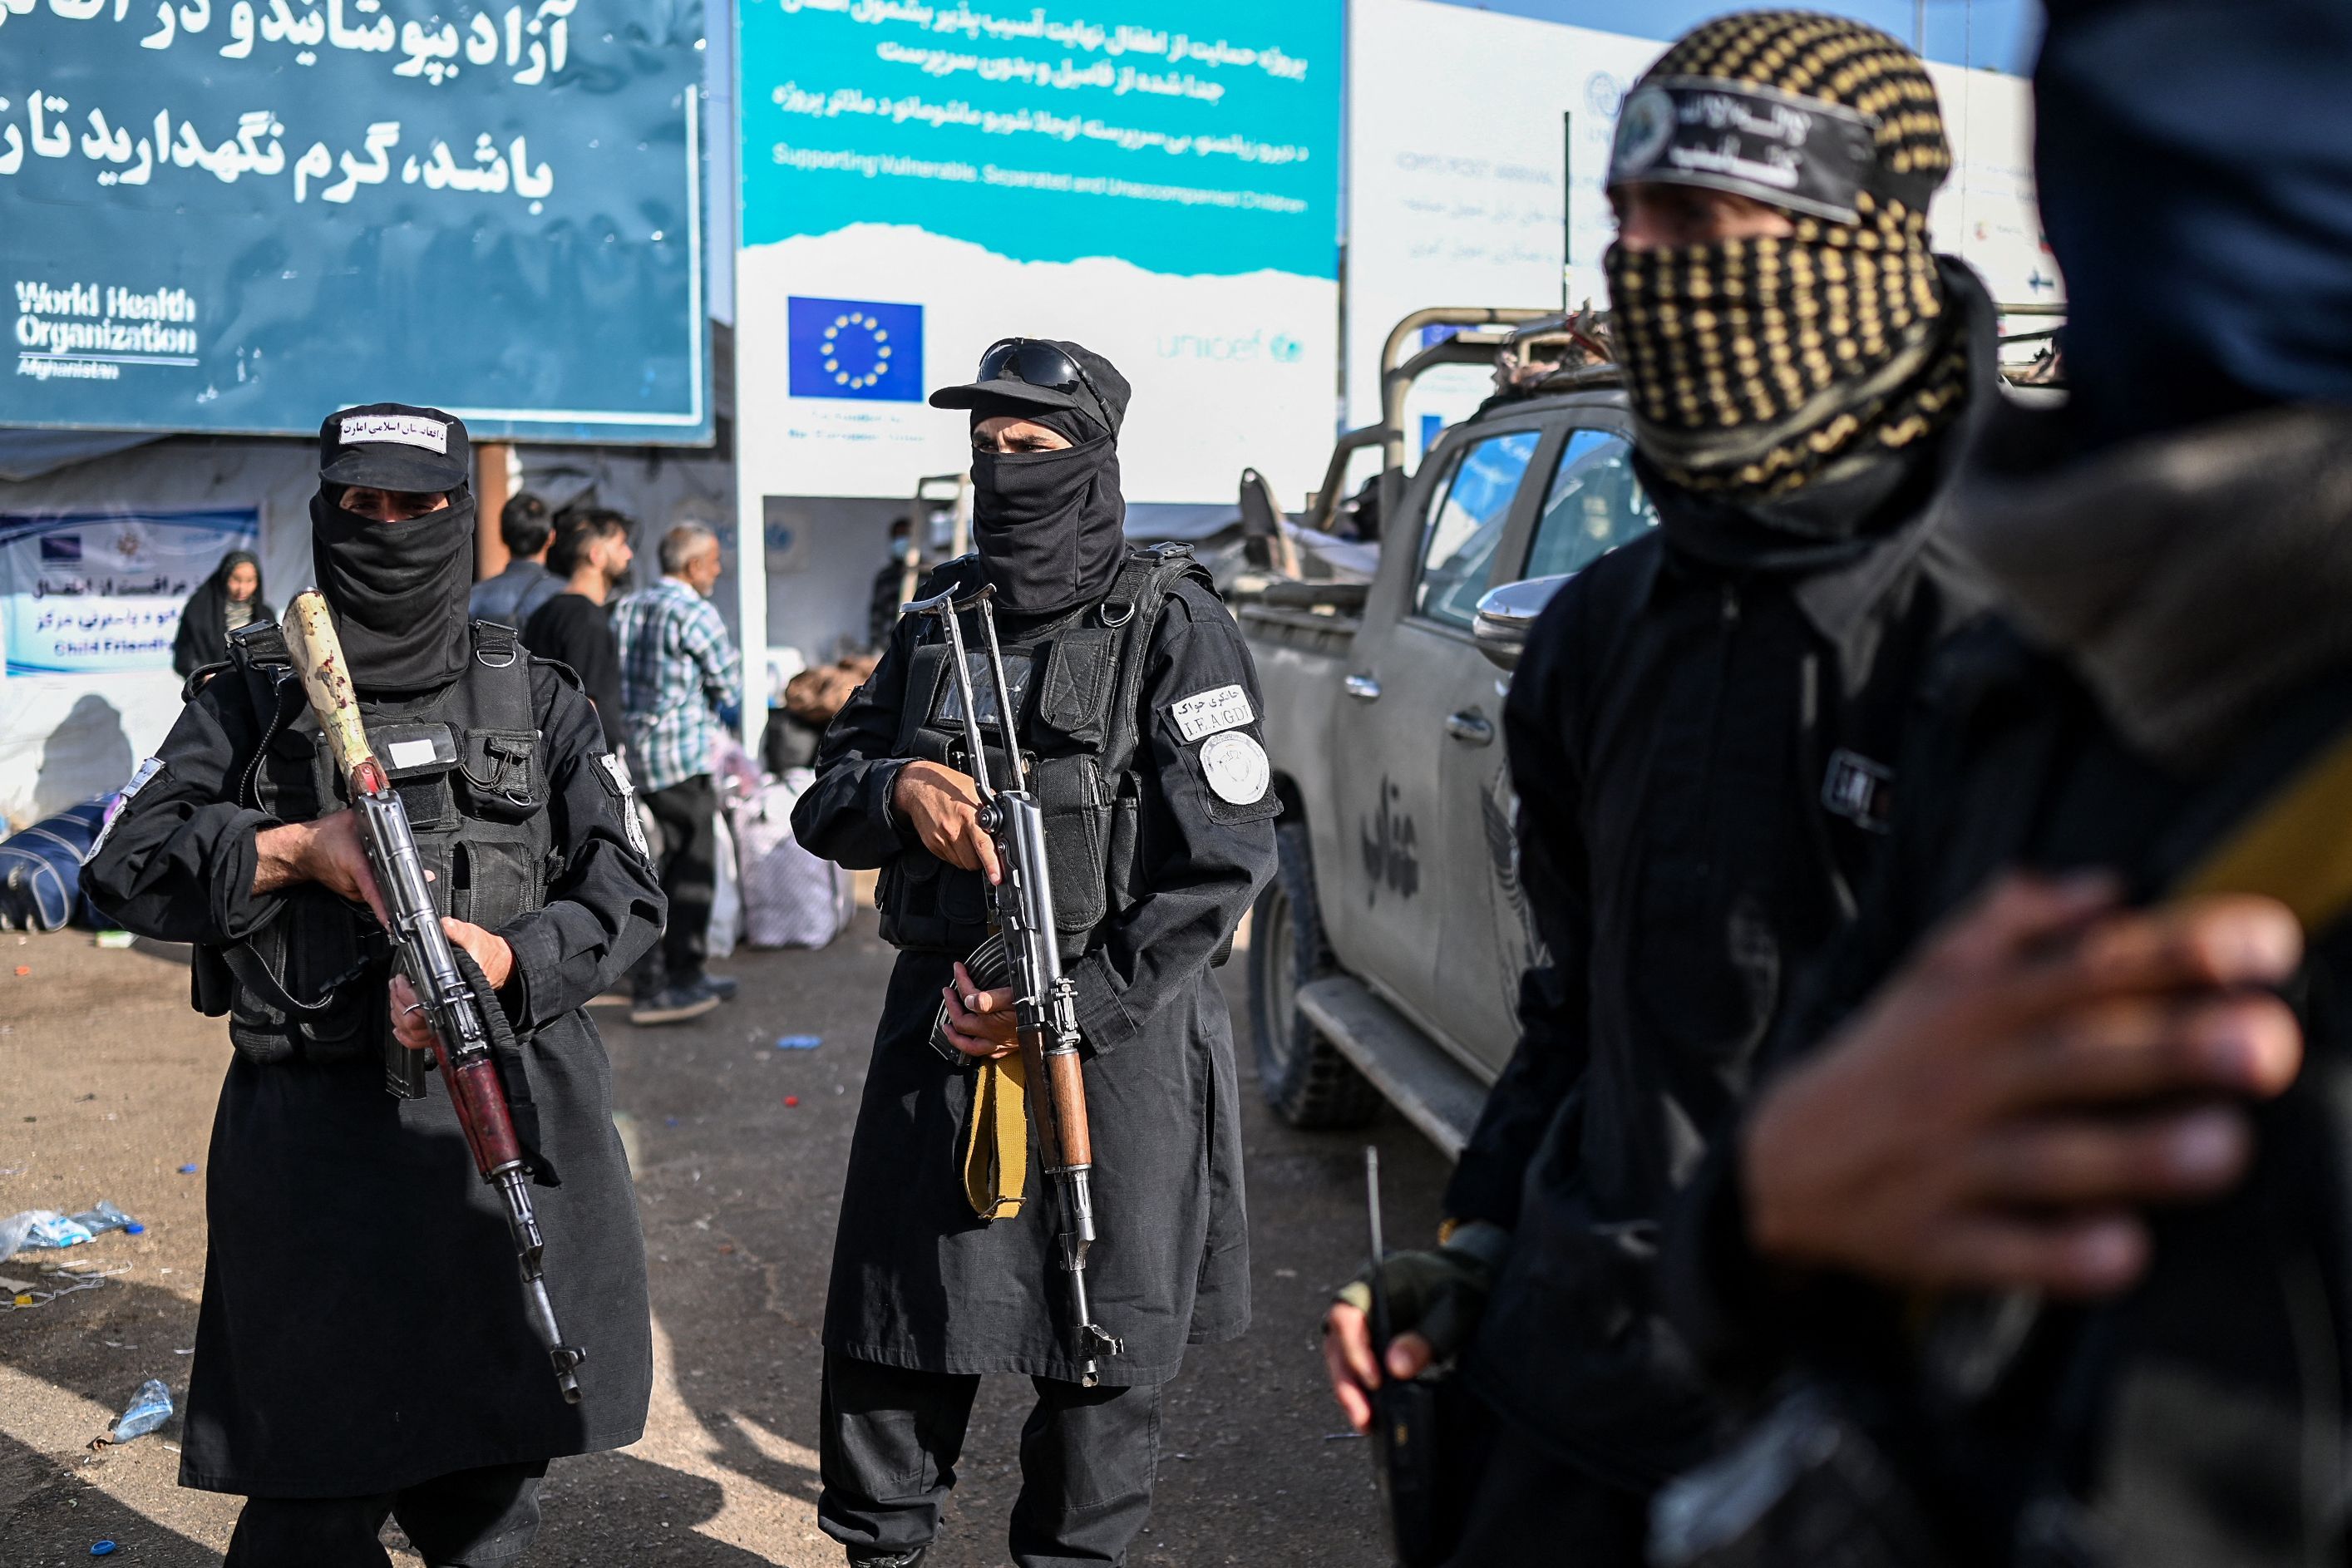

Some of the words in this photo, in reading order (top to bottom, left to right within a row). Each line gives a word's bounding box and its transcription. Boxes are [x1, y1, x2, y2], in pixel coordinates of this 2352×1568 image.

[140, 0, 210, 50] در
[466, 0, 578, 85] آزاد
[27, 89, 71, 158] تا
[81, 106, 285, 186] نگهدارید
[294, 121, 400, 203] گرم
[772, 142, 878, 178] Supporting
[1073, 176, 1106, 195] and
[15, 280, 100, 318] World
[106, 286, 196, 323] Health
[16, 313, 198, 354] Organization
[16, 357, 120, 381] Afghanistan
[54, 641, 99, 656] Child
